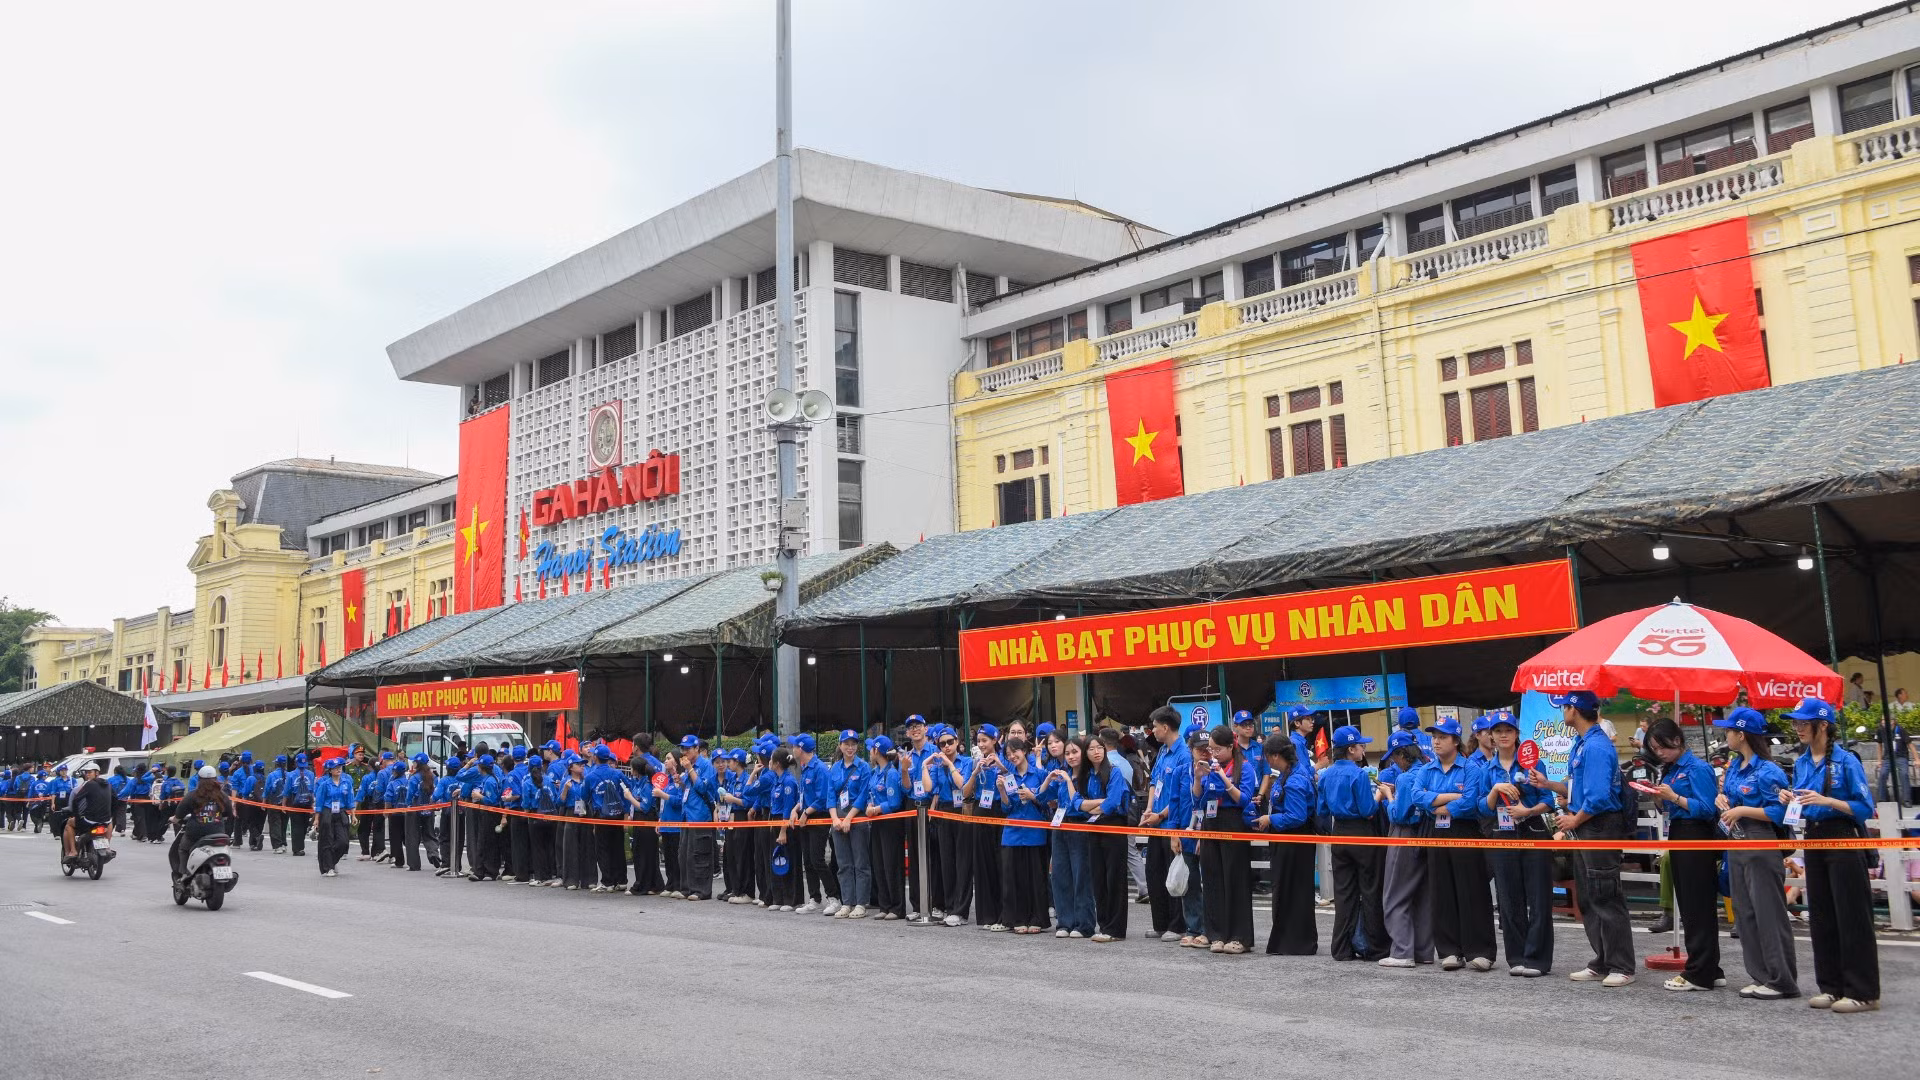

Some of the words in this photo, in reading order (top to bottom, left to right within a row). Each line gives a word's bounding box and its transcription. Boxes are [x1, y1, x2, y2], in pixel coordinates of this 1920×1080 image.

[621, 448, 680, 505] NỘI
[534, 540, 594, 582] Hanoi
[597, 525, 682, 569] Station
[988, 630, 1049, 667] NHÀ
[1056, 628, 1114, 665] BẠT
[1124, 618, 1217, 658] PHỤC
[1226, 610, 1276, 651] VỤ
[1288, 594, 1406, 641] NHÂN
[1419, 582, 1519, 628] DÂN
[1637, 635, 1707, 656] 5G
[1531, 669, 1585, 687] viettel
[1756, 678, 1826, 699] viettel
[387, 689, 409, 710] NHÀ
[412, 691, 433, 711] BẠT
[436, 688, 468, 710] PHỤC
[471, 686, 488, 708] VỤ
[491, 681, 528, 704] NHÂN
[532, 679, 562, 702] DÂN
[1522, 745, 1533, 757] 5G
[1791, 807, 1798, 815] N
